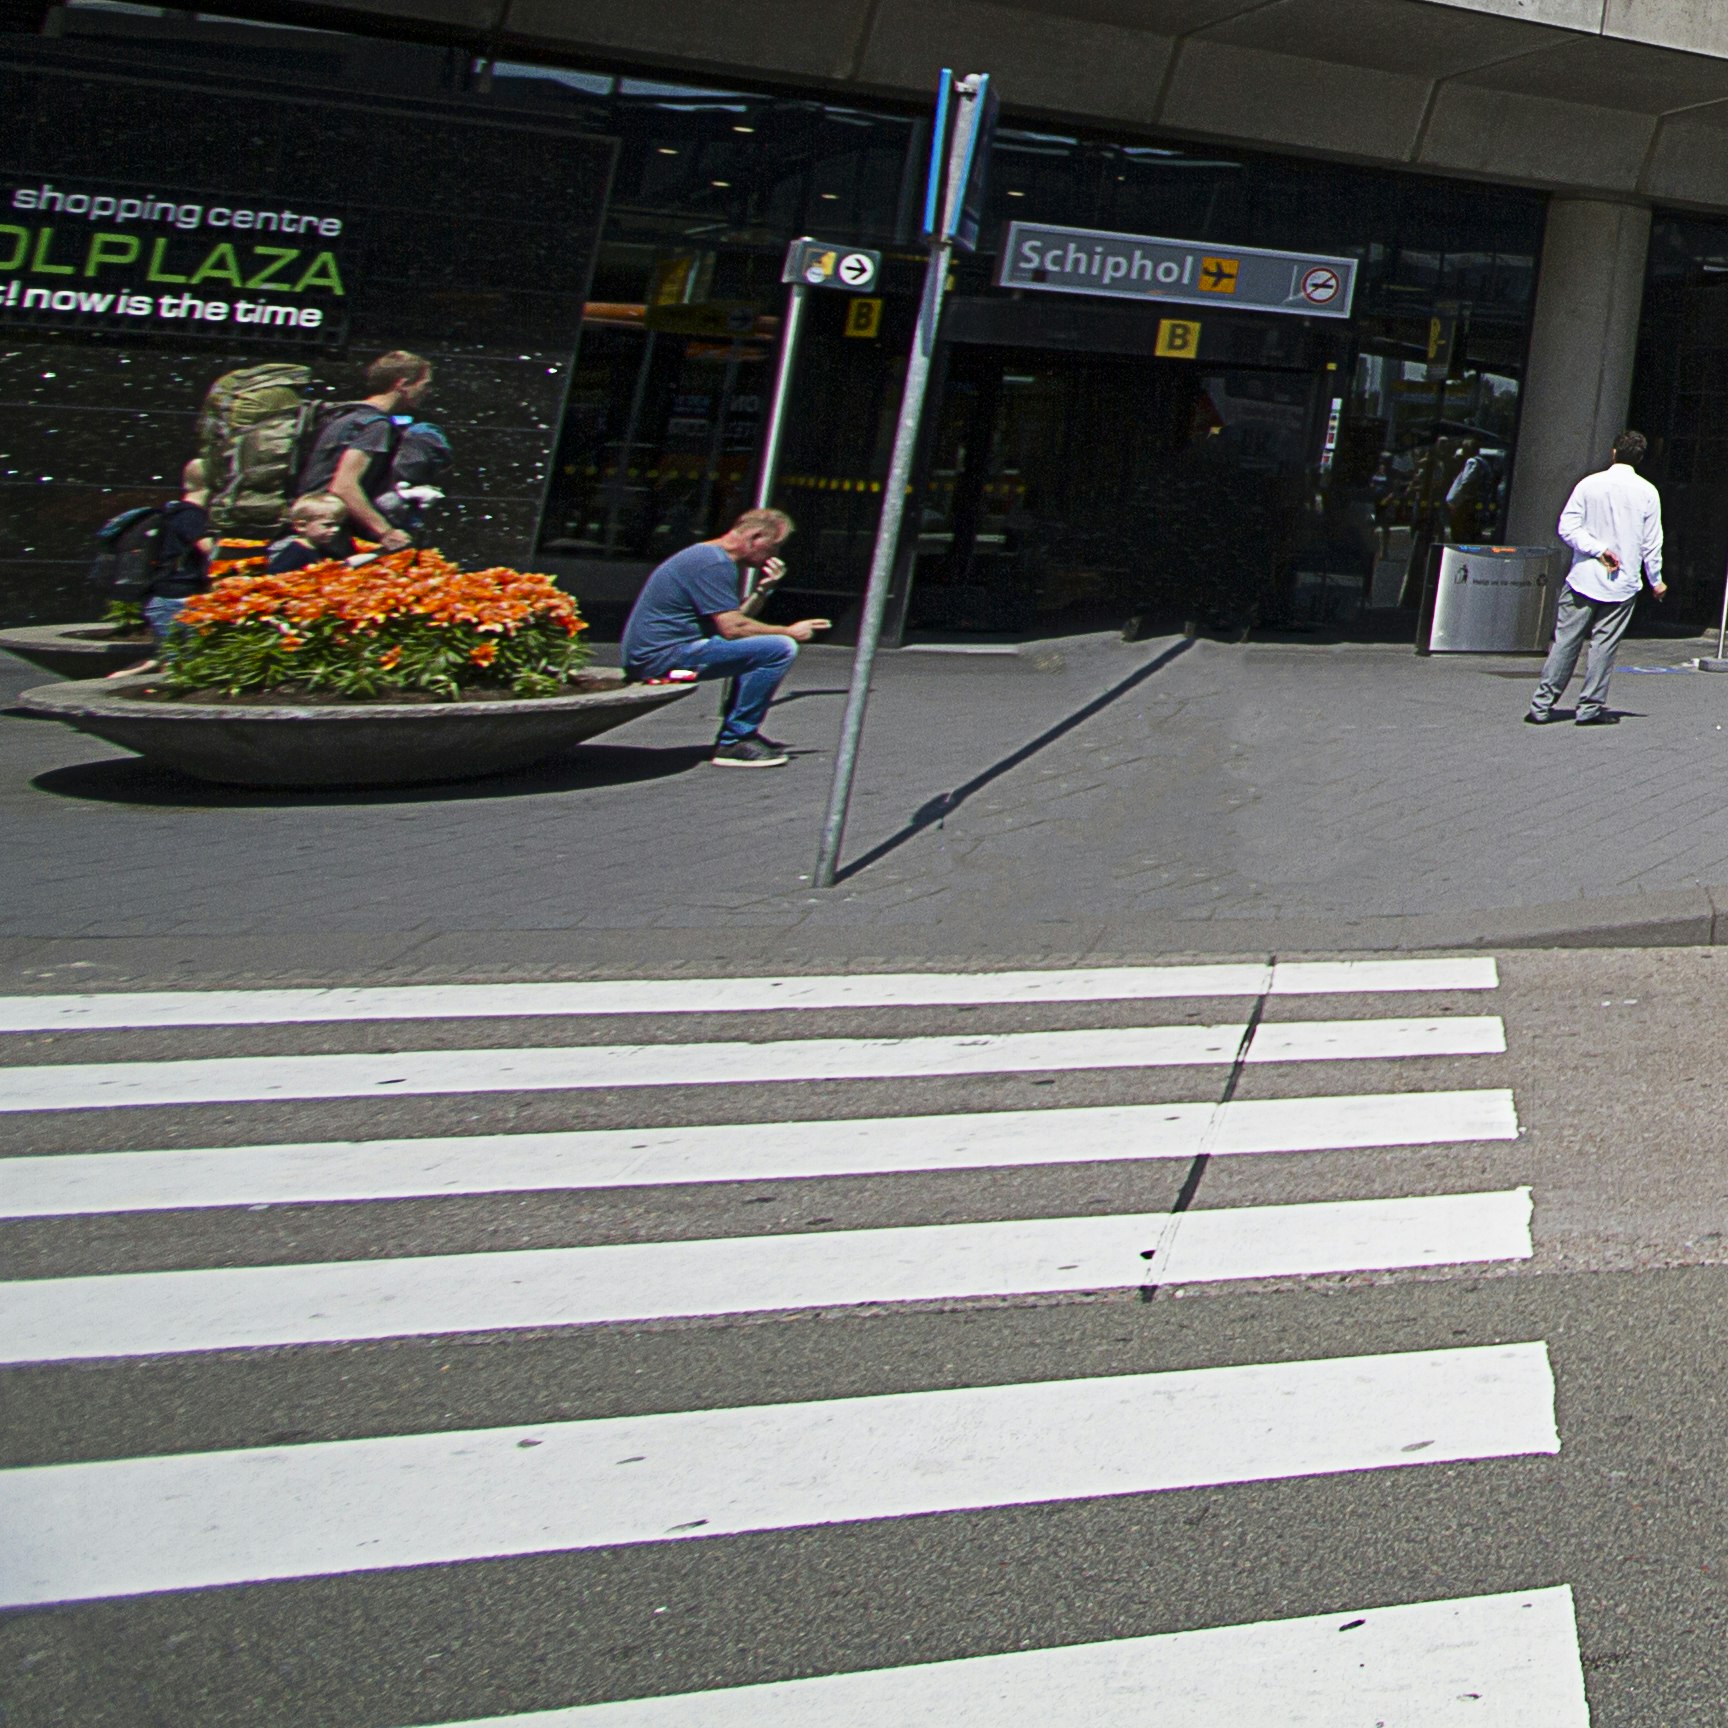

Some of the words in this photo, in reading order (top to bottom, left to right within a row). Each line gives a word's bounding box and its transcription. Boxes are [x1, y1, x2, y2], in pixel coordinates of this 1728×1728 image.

[12, 184, 203, 229] shopping
[207, 207, 343, 237] centre
[84, 232, 345, 296] PLAZA
[1018, 240, 1193, 284] Schiphol
[22, 288, 115, 313] now
[116, 288, 154, 316] is
[157, 293, 229, 321] the
[234, 298, 323, 328] time
[852, 301, 874, 330] B
[1167, 323, 1190, 351] B
